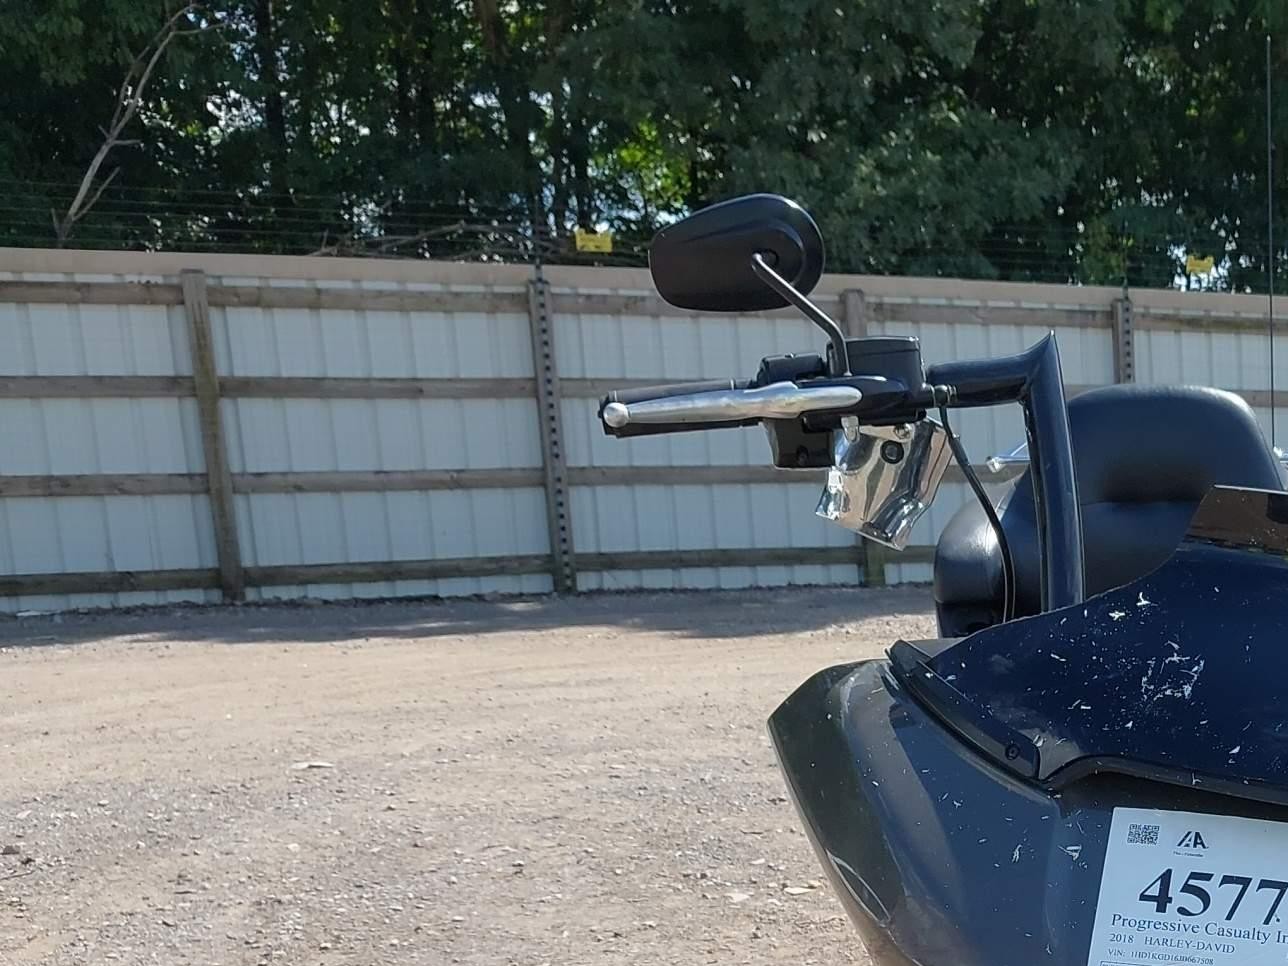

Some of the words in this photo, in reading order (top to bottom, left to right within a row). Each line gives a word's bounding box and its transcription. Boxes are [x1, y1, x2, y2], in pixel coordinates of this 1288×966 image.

[1111, 914, 1200, 933] Progressive
[1205, 922, 1271, 944] Casualty
[1109, 933, 1134, 944] 2018
[1144, 936, 1235, 953] HARLEY-DAVID
[1108, 949, 1126, 958] VIN:
